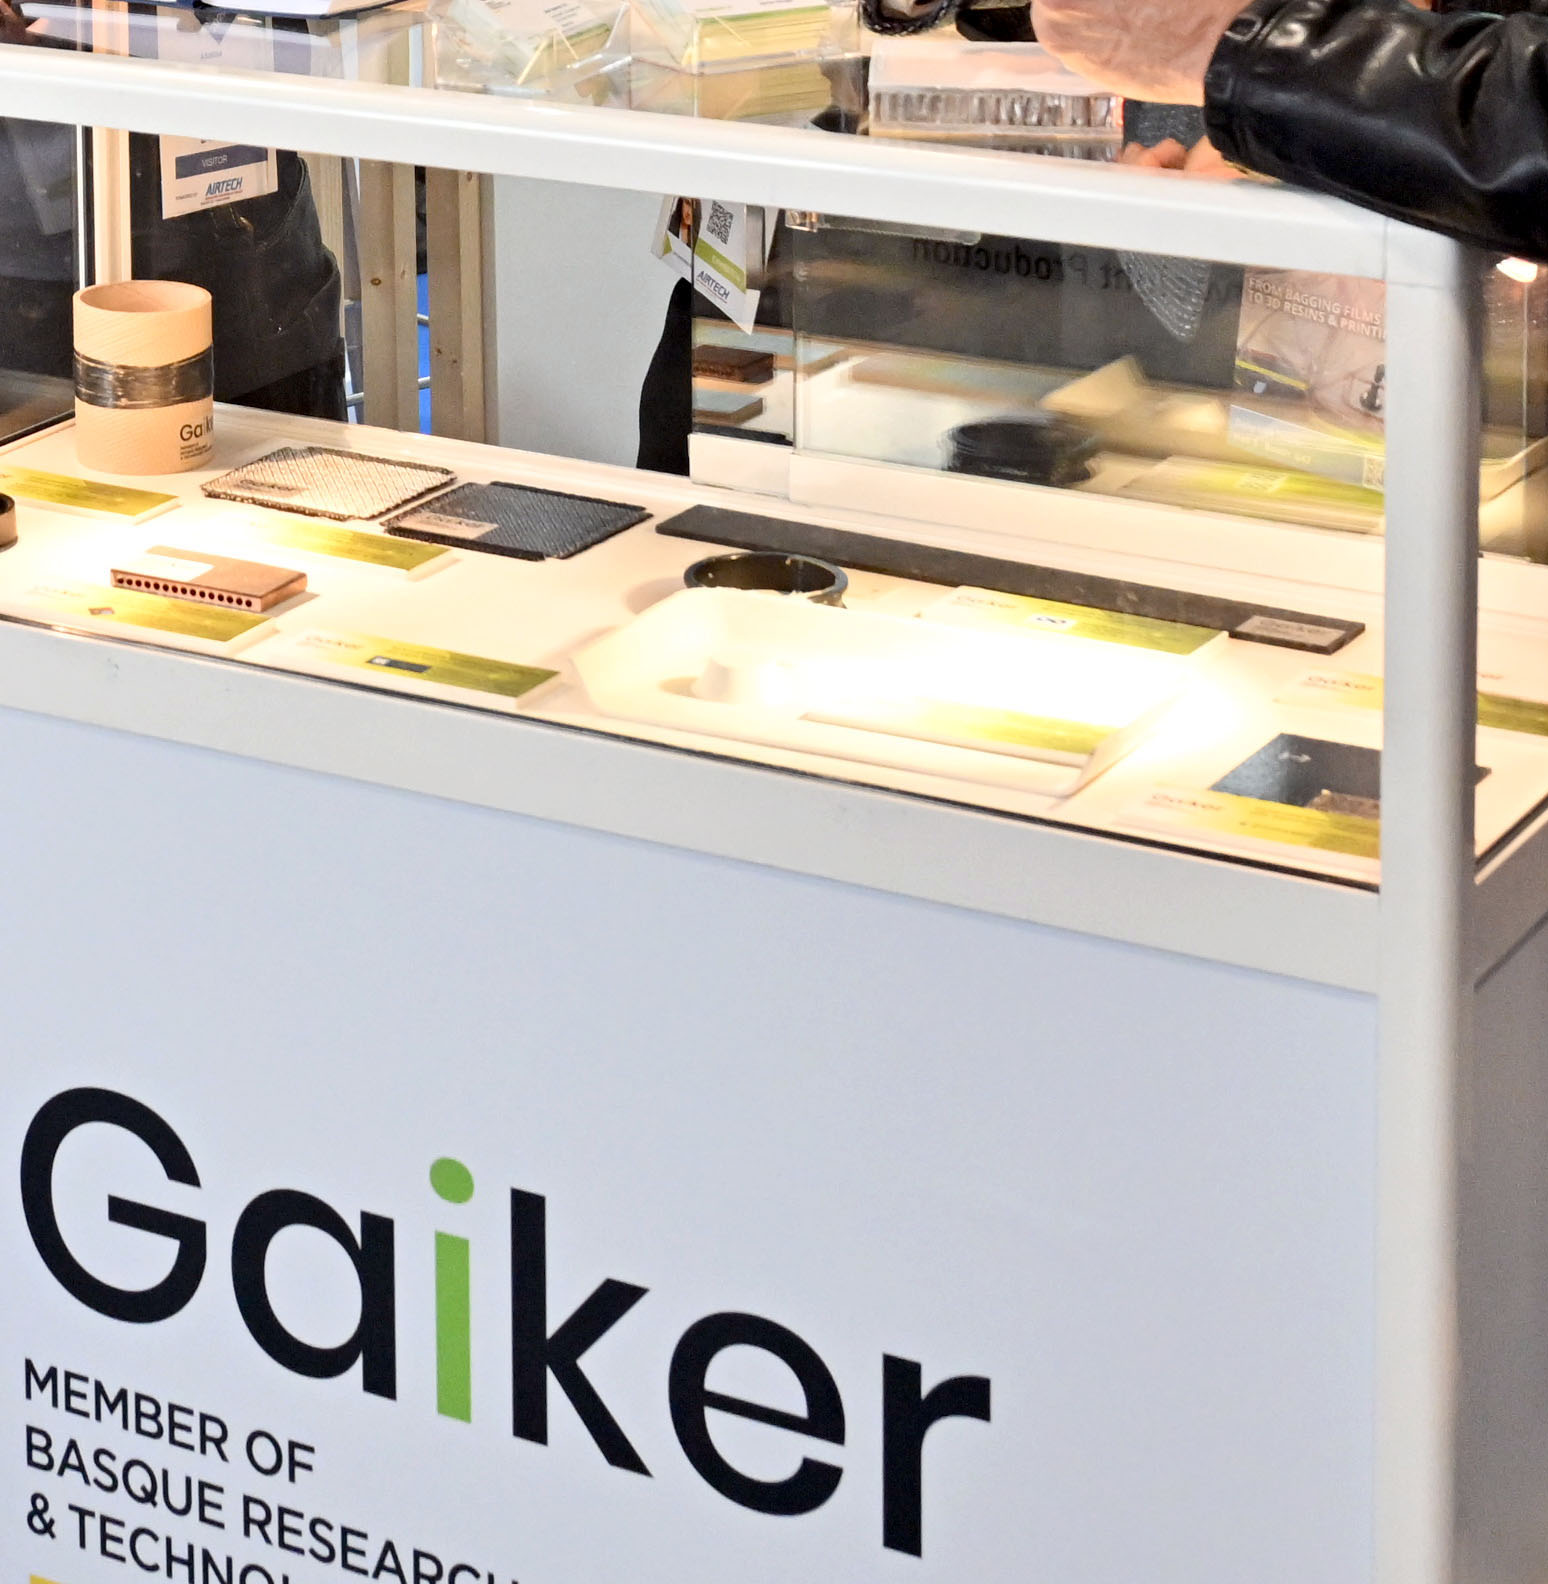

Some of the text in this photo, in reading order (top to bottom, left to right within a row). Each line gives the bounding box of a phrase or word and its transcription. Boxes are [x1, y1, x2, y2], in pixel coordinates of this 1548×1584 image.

[20, 1086, 992, 1559] Gaiker
[24, 1358, 316, 1484] MEMBER OF
[25, 1425, 225, 1530] BASQUE
[26, 1493, 56, 1539] &
